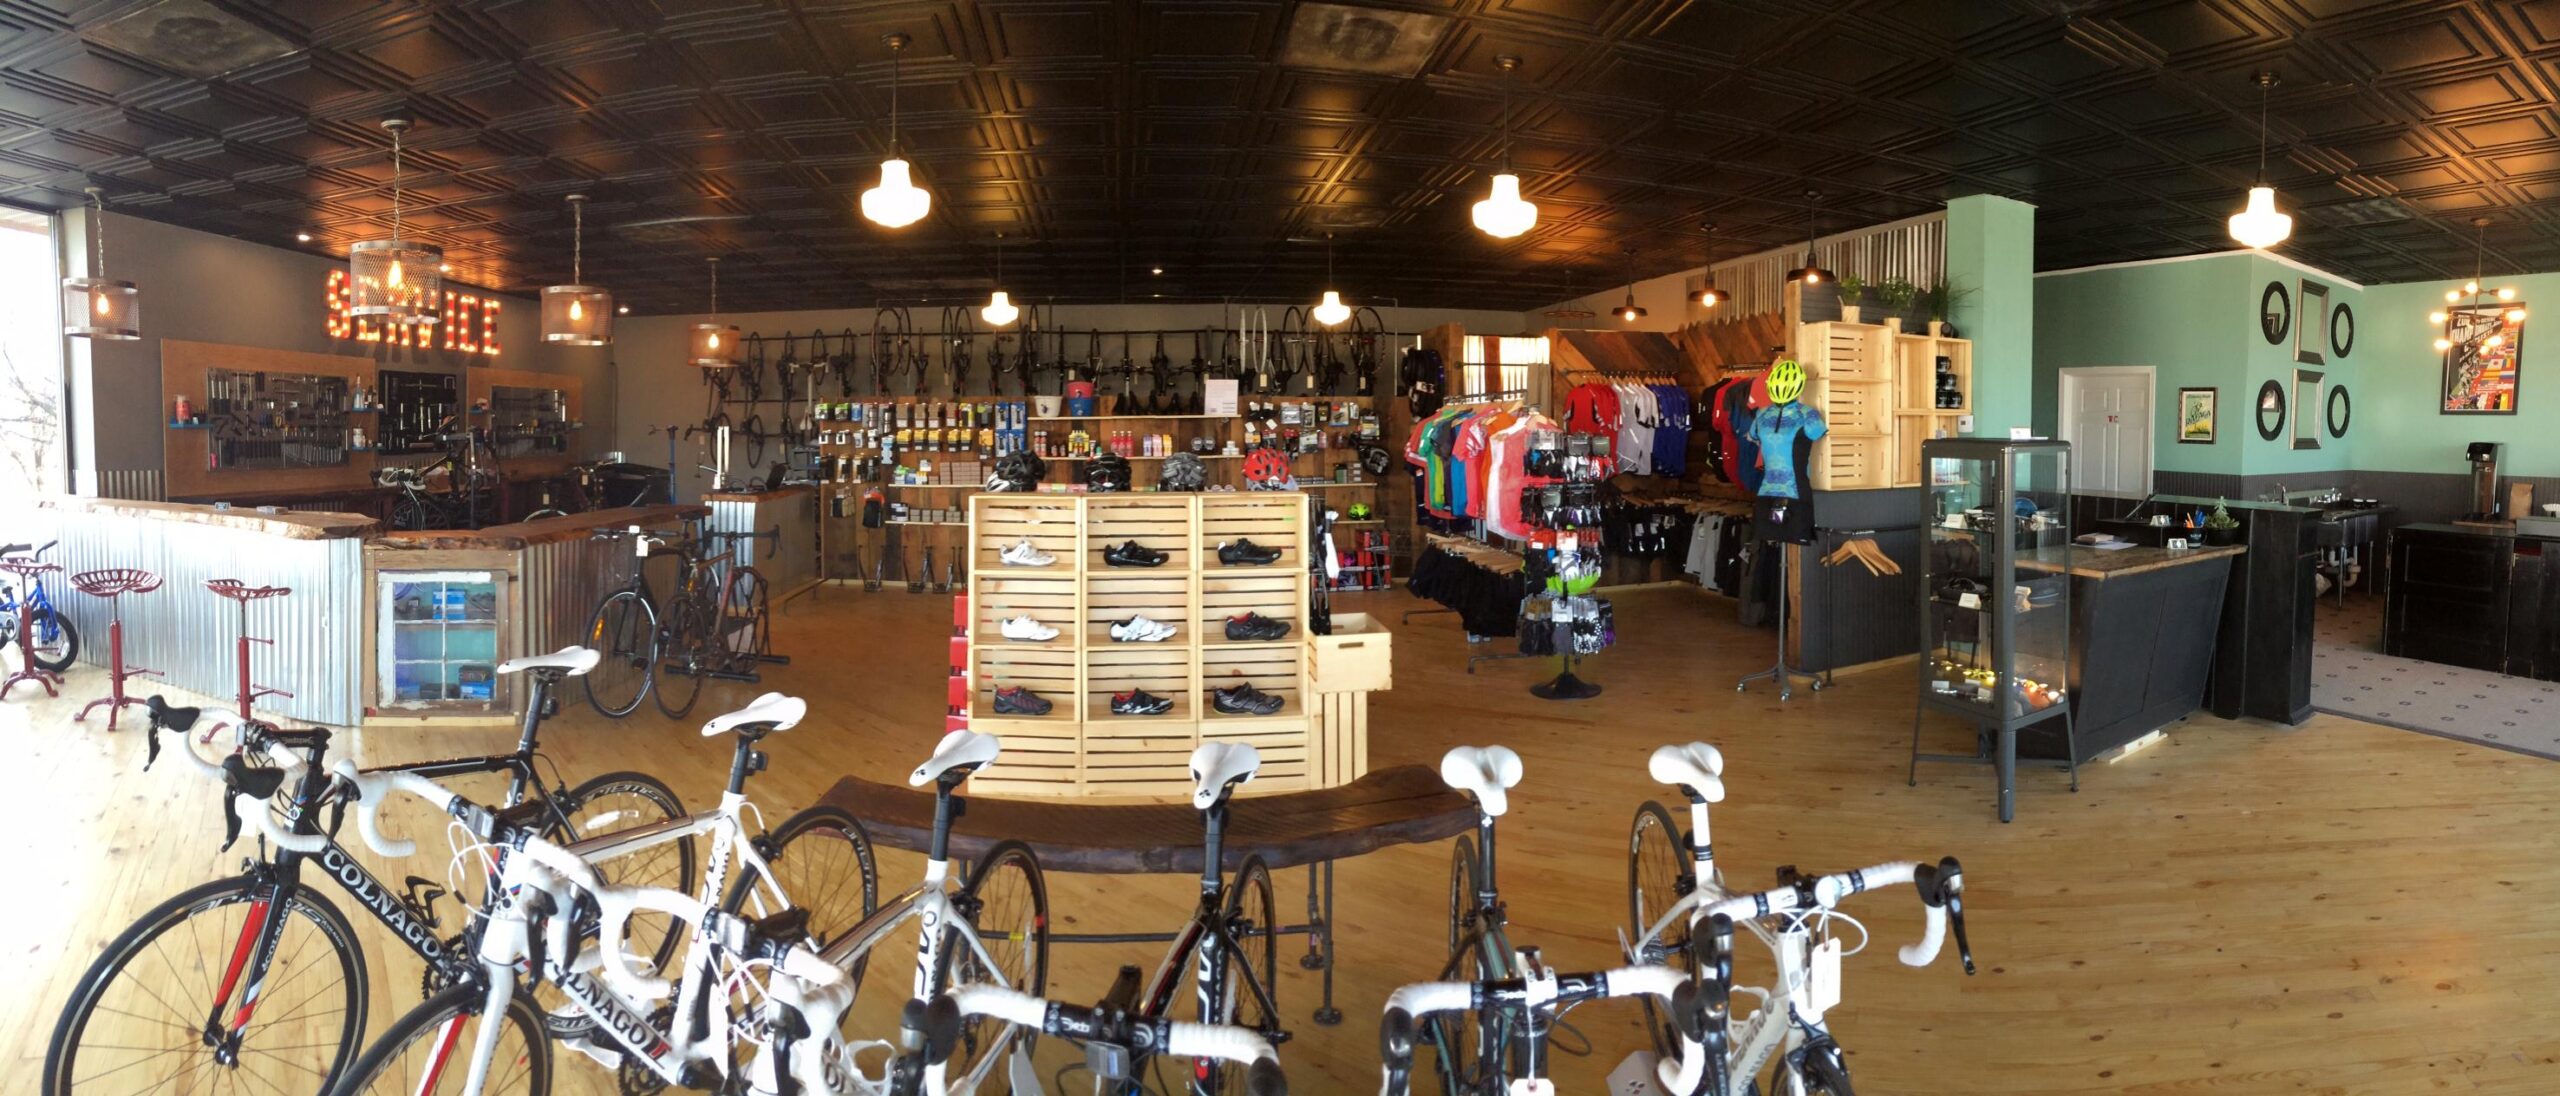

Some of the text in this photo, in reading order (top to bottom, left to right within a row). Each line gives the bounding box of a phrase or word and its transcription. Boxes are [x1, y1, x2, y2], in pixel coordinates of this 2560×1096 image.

[325, 269, 502, 355] SERVICE
[264, 898, 293, 965] COLNAGO
[323, 849, 442, 959] COLNAGO
